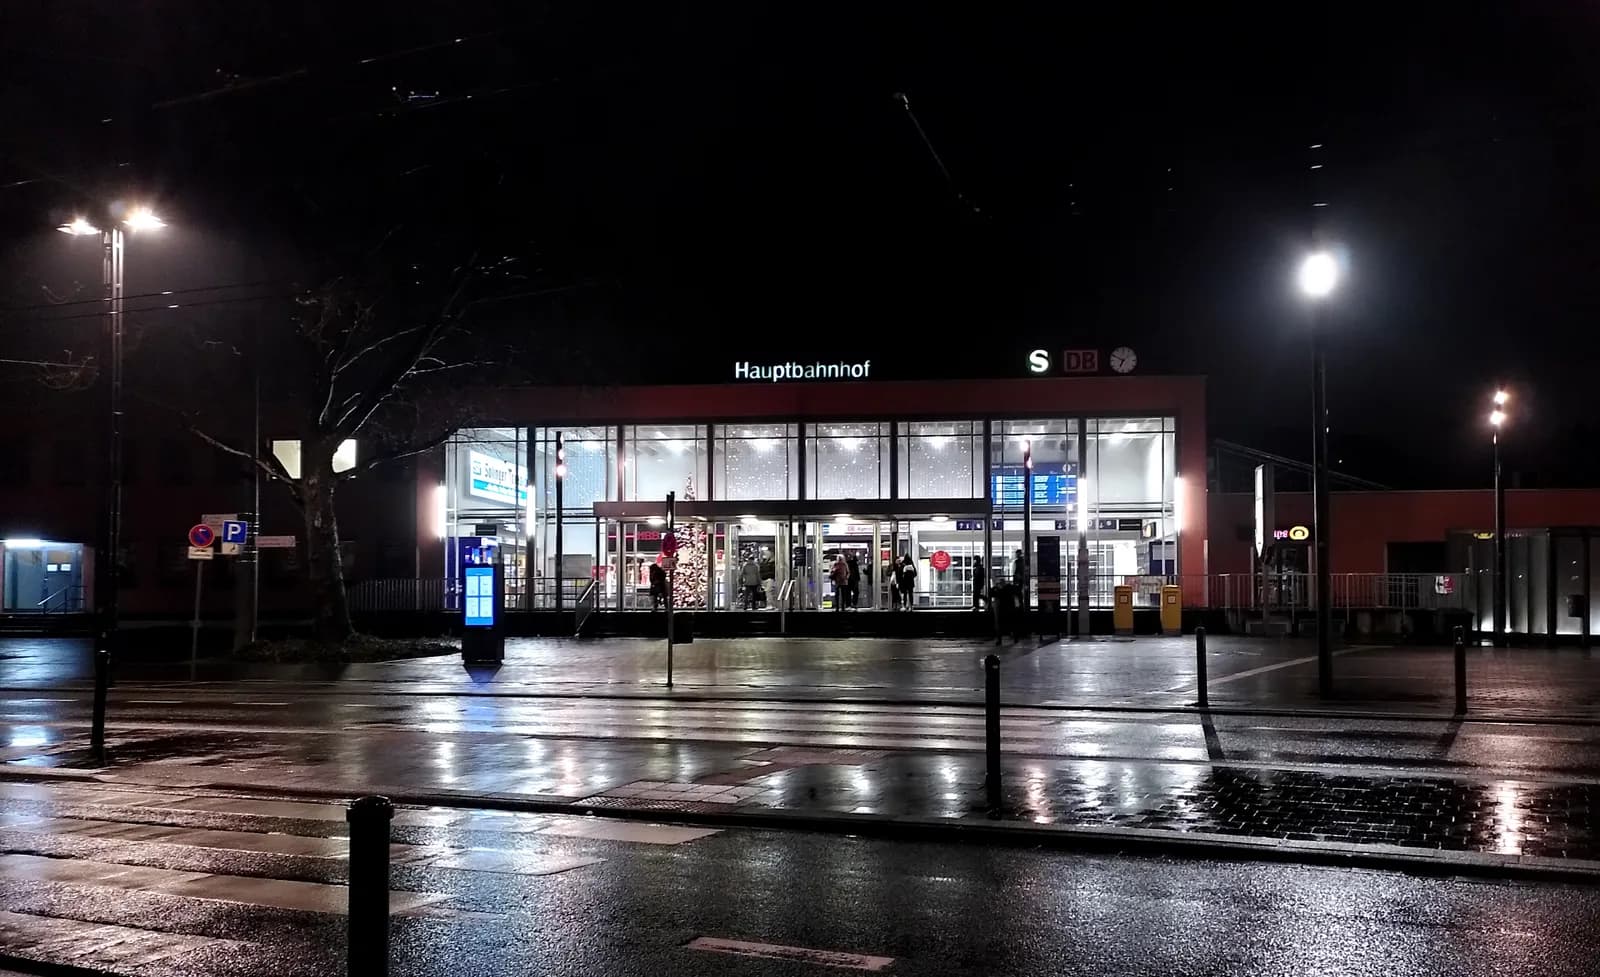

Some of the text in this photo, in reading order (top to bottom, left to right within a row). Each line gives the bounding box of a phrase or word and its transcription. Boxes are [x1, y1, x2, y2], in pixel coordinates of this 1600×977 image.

[735, 359, 871, 382] Hauptbahnhof
[1029, 349, 1049, 373] S
[1066, 351, 1096, 370] DB
[227, 523, 242, 541] P
